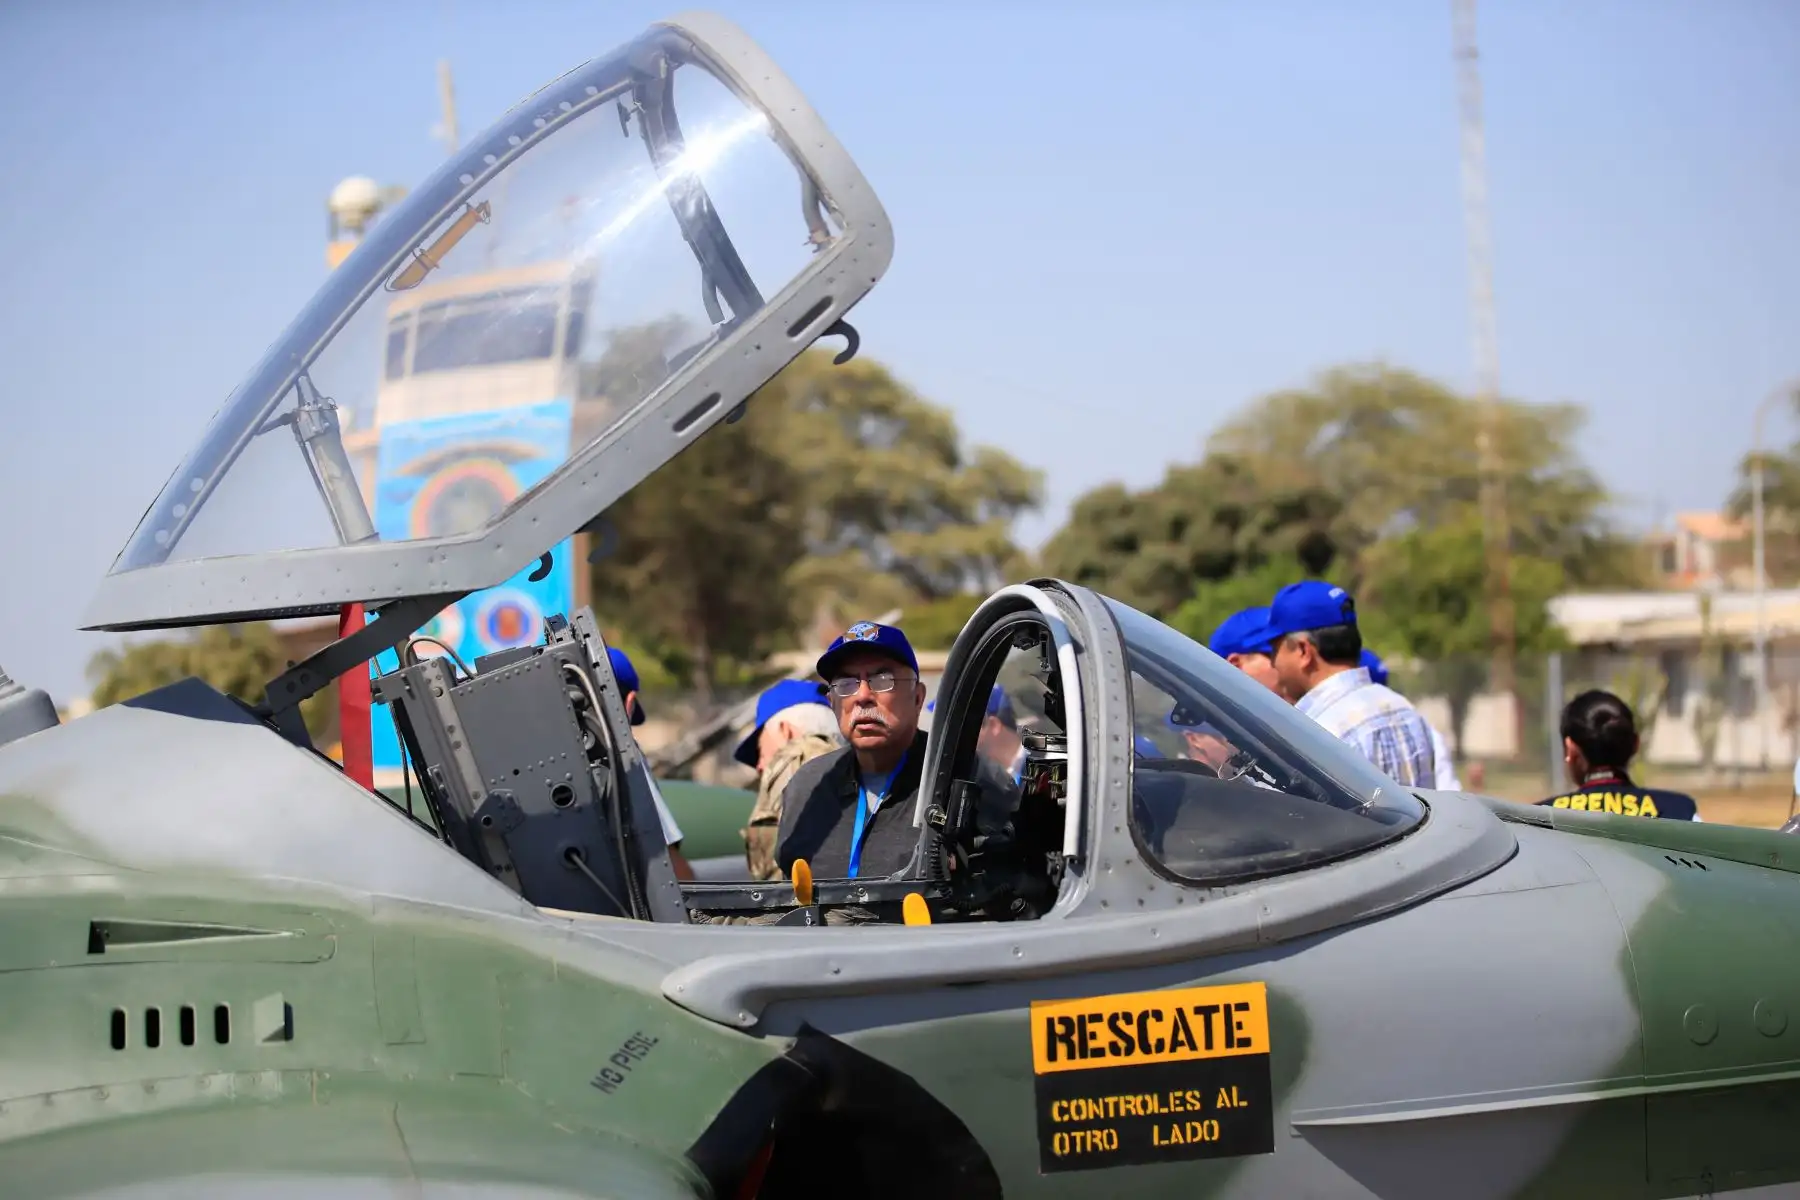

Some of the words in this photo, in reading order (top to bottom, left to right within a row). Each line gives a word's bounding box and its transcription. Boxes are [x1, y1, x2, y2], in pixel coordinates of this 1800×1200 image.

[1046, 1002, 1252, 1062] RESCATE
[590, 1067, 625, 1095] NO
[609, 1030, 659, 1072] PISE
[1052, 1090, 1201, 1122] CONTROLES
[1216, 1086, 1248, 1109] AL
[1053, 1128, 1118, 1156] OTRO
[1153, 1119, 1220, 1146] LADO
